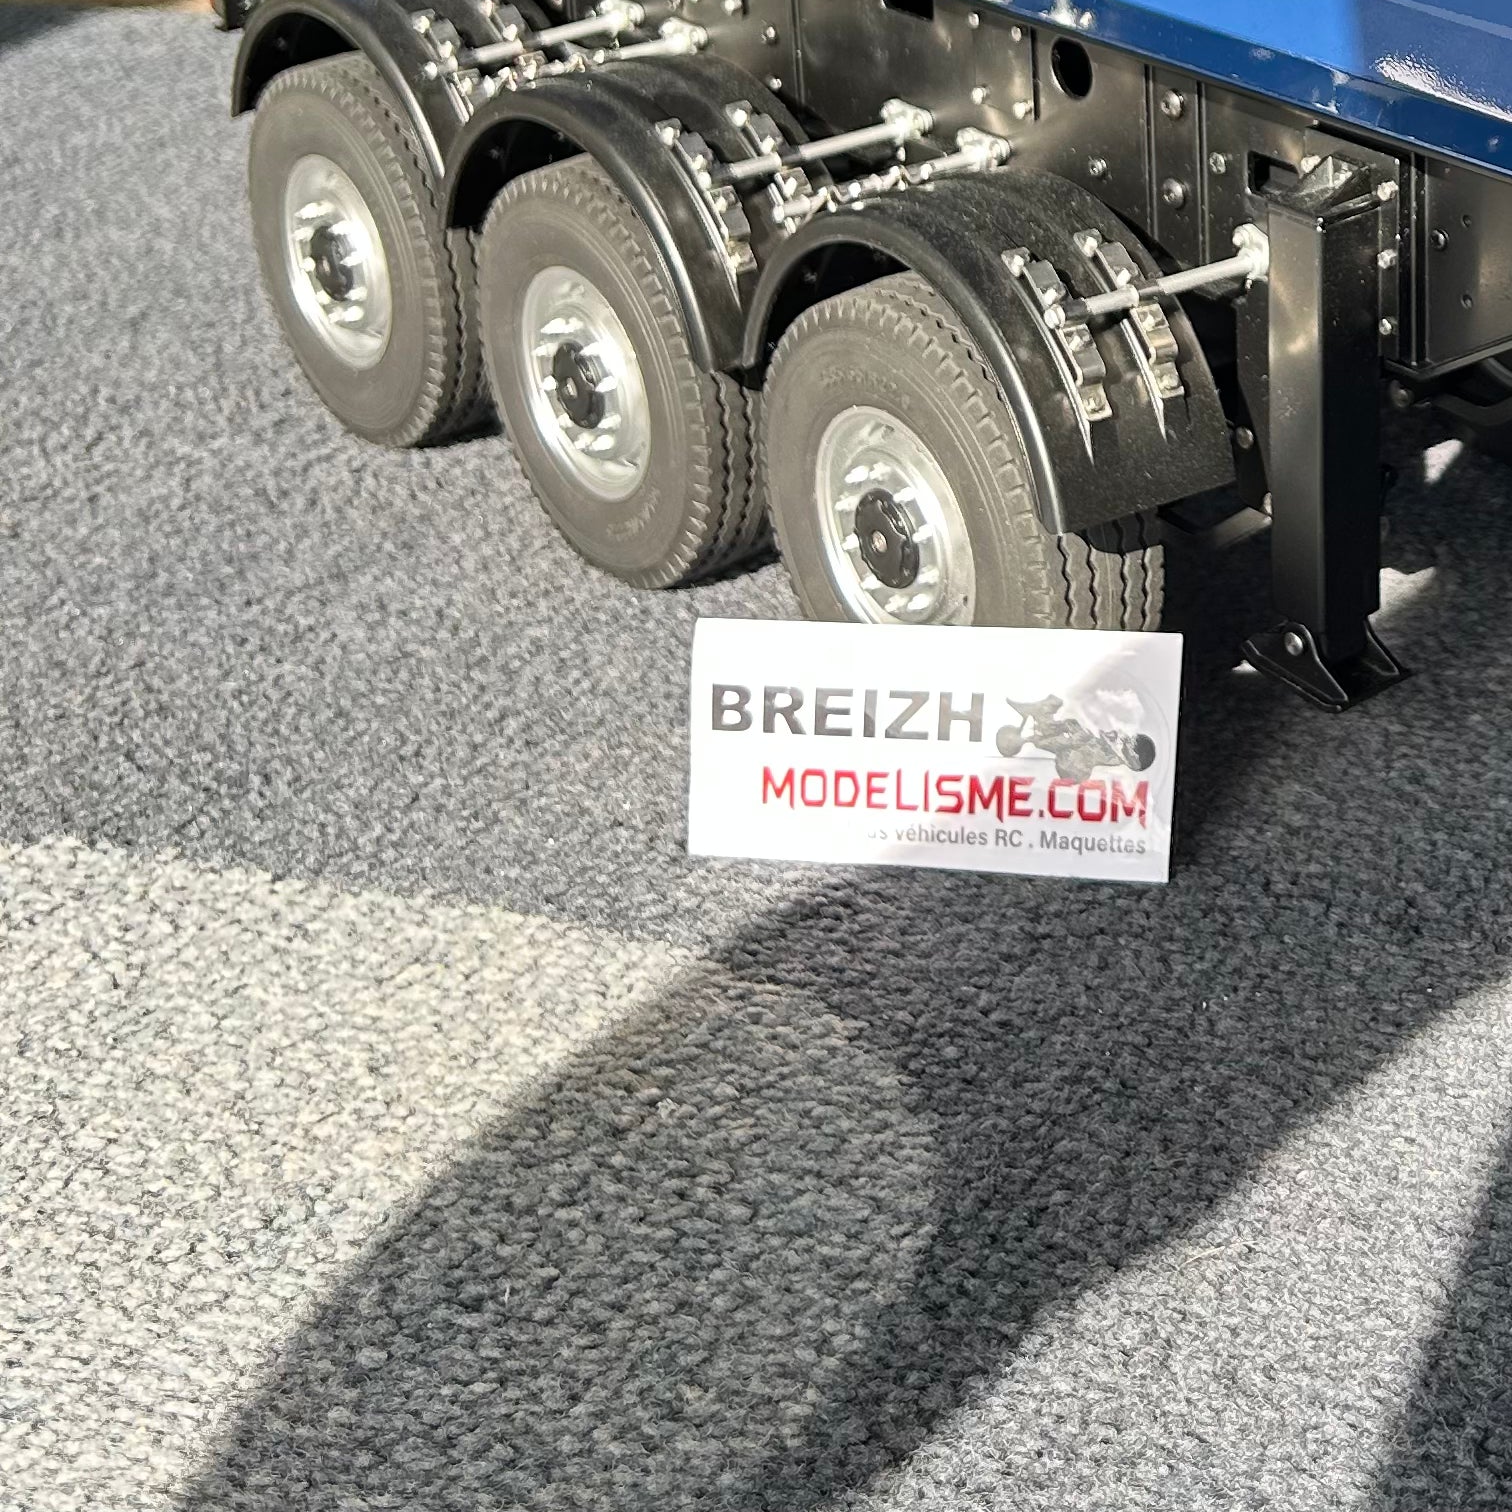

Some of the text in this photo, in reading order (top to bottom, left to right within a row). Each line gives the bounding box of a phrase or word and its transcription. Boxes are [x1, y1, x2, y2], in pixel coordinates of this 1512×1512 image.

[711, 682, 985, 743] BREIZH
[761, 765, 1149, 829] MODELISME.COM
[895, 823, 988, 846] véhicules
[994, 828, 1023, 848] RC
[1039, 830, 1146, 856] Maquettes
